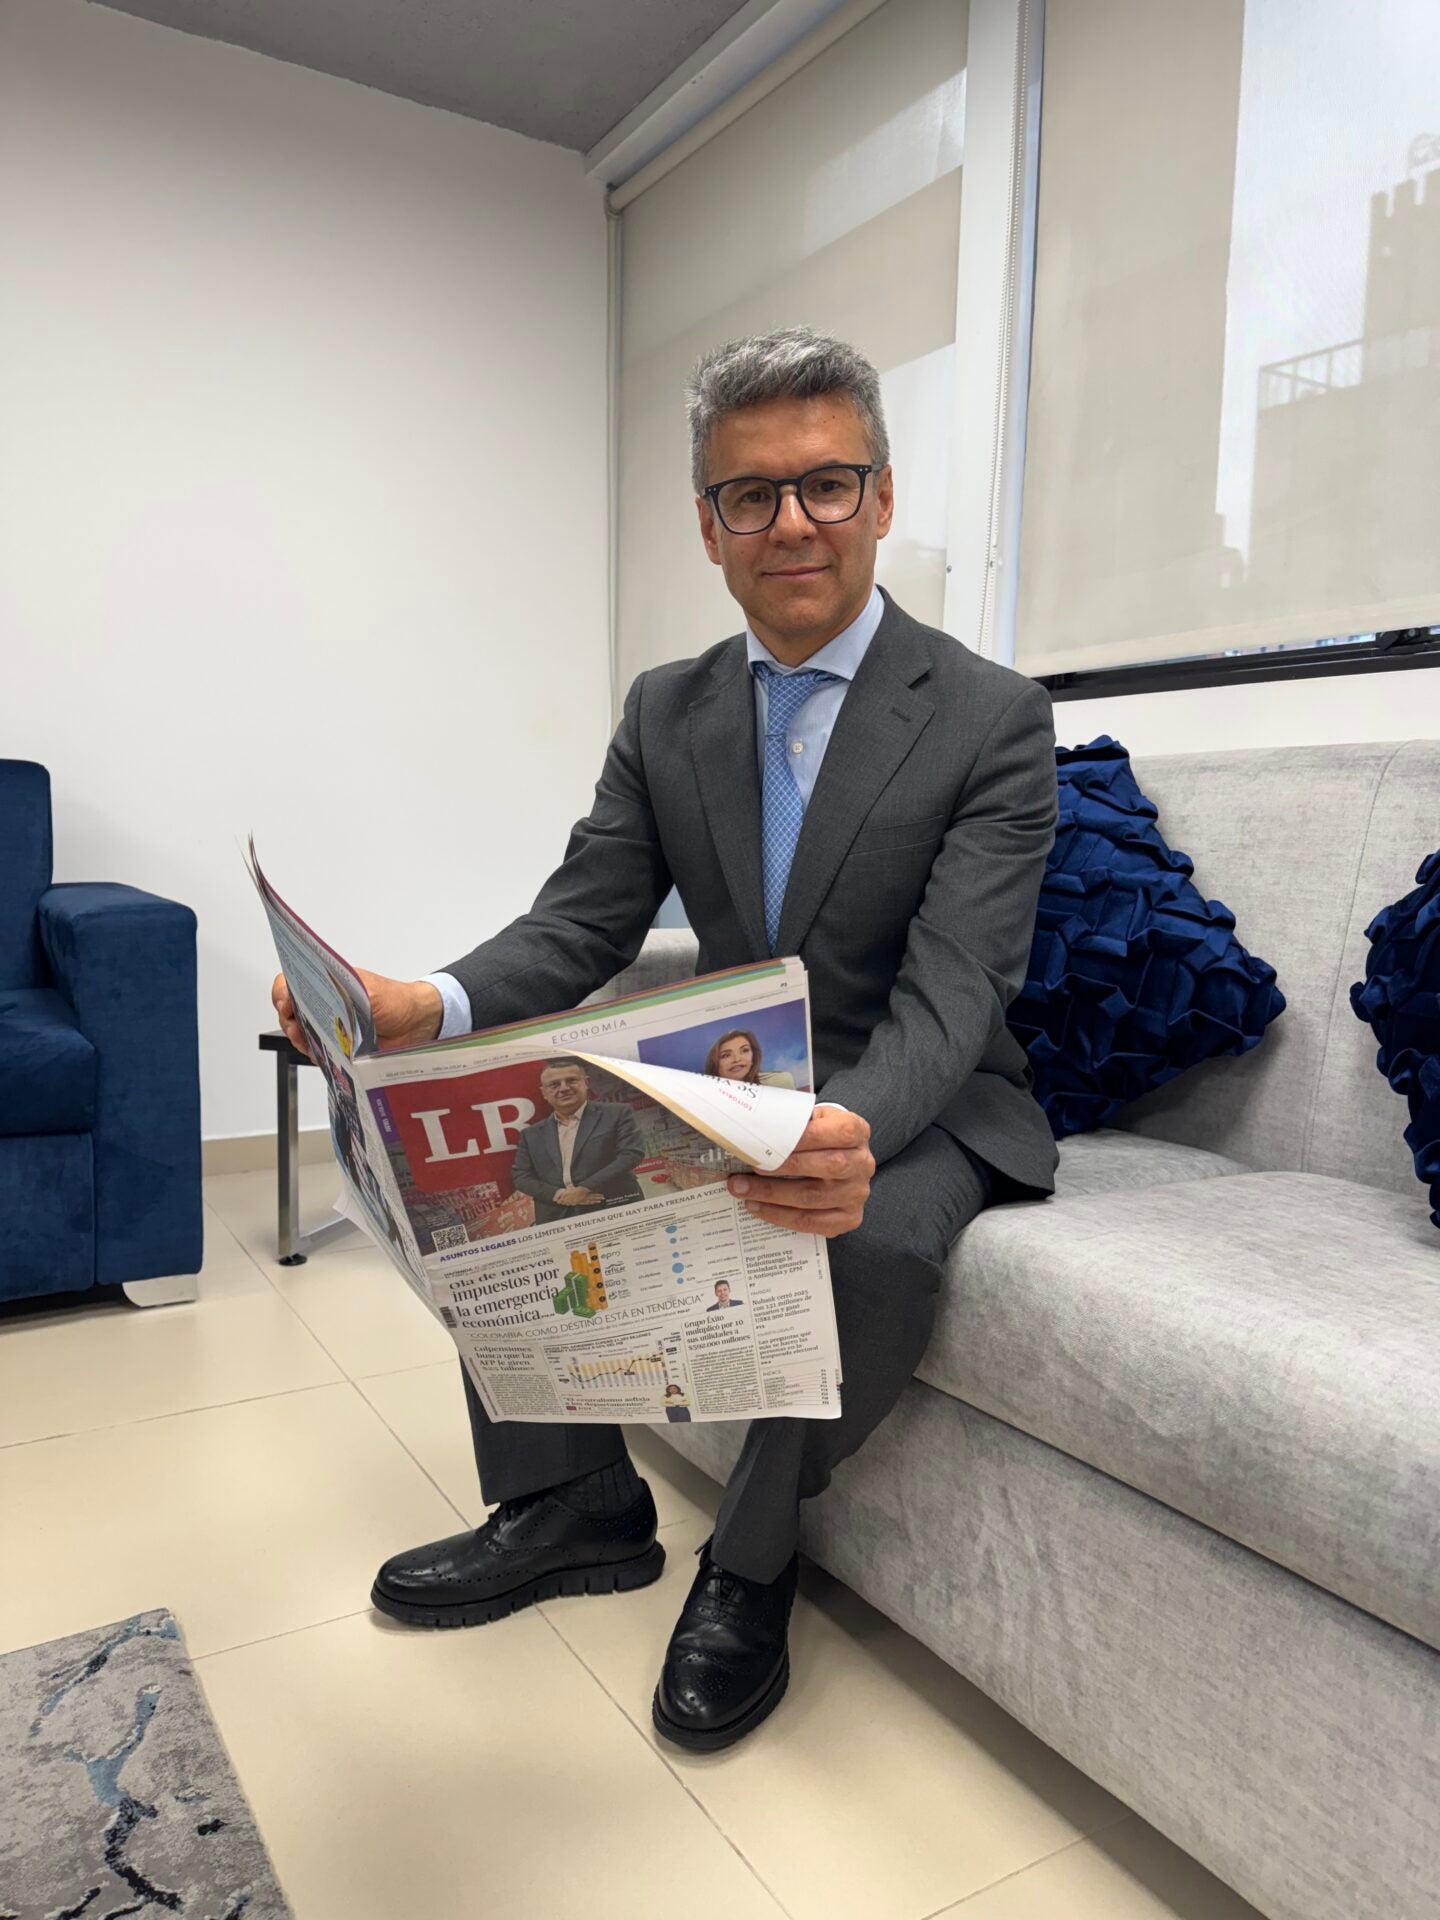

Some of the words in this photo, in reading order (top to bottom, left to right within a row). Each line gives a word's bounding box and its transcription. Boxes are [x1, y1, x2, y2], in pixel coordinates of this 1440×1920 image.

[551, 1018, 628, 1045] ECONOMÍA
[410, 1097, 536, 1163] LR
[440, 1248, 479, 1262] ASUNTOS
[481, 1238, 517, 1253] LEGALES
[518, 1234, 533, 1244] LOS
[534, 1226, 566, 1240] LÍMITES
[567, 1223, 574, 1231] Y
[574, 1216, 606, 1229] MULTAS
[607, 1212, 623, 1221] QUE
[625, 1208, 642, 1217] HAY
[644, 1202, 664, 1212] PARA
[665, 1195, 695, 1206] FRENAR
[600, 1249, 622, 1260] epm
[756, 1252, 781, 1262] primera
[746, 1256, 787, 1269] Hidroituango
[778, 1259, 808, 1270] ganancias
[449, 1279, 474, 1290] Ola
[479, 1273, 497, 1282] de
[501, 1258, 555, 1277] nuevos
[604, 1265, 625, 1276] reficar
[753, 1269, 783, 1280] Antioquia
[452, 1275, 530, 1303] impuestos
[534, 1267, 560, 1286] por
[456, 1305, 471, 1318] la
[474, 1285, 560, 1313] emergencia
[752, 1296, 775, 1306] Nubank
[777, 1298, 804, 1307] millones
[525, 1325, 559, 1338] COMO
[561, 1316, 602, 1333] DESTINO
[604, 1309, 630, 1325] ESTÁ
[631, 1307, 644, 1318] EN
[684, 1318, 706, 1330] Grupo
[706, 1315, 724, 1324] Éxito
[685, 1323, 720, 1337] multiplicó
[721, 1321, 733, 1330] por
[699, 1330, 733, 1341] utilidades
[721, 1335, 751, 1344] millones
